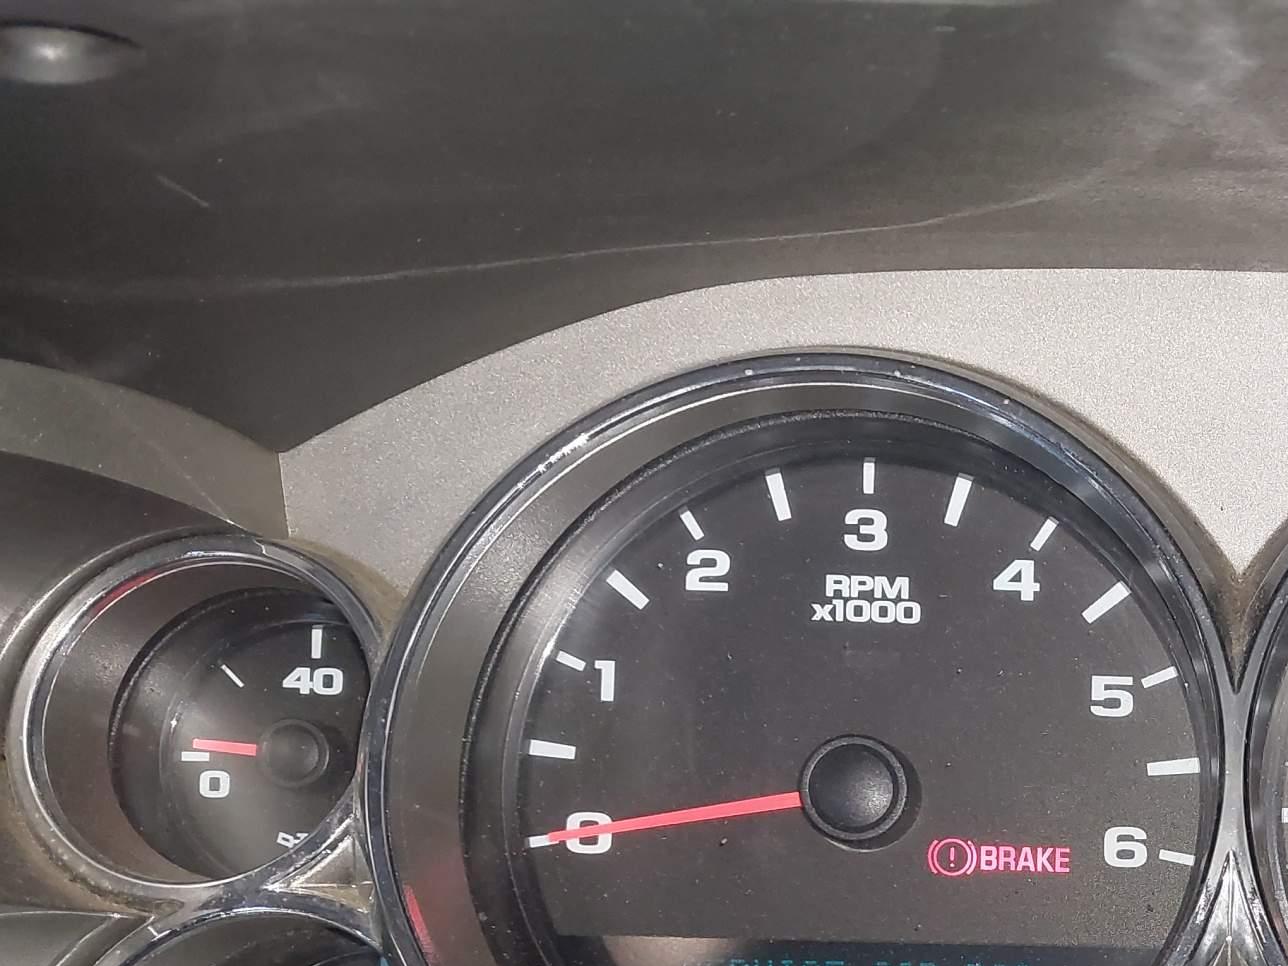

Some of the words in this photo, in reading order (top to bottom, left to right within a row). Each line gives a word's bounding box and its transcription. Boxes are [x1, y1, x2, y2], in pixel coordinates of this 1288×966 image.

[843, 508, 888, 551] 3
[685, 549, 731, 592] 2
[825, 574, 910, 602] RPM
[992, 559, 1041, 602] 4
[811, 600, 921, 625] x1000
[282, 667, 344, 696] 40
[594, 660, 616, 702] 1
[1090, 675, 1134, 718] 5
[199, 770, 231, 798] 0
[565, 812, 613, 854] 0
[1103, 826, 1148, 868] 6
[979, 844, 1071, 873] BRAKE
